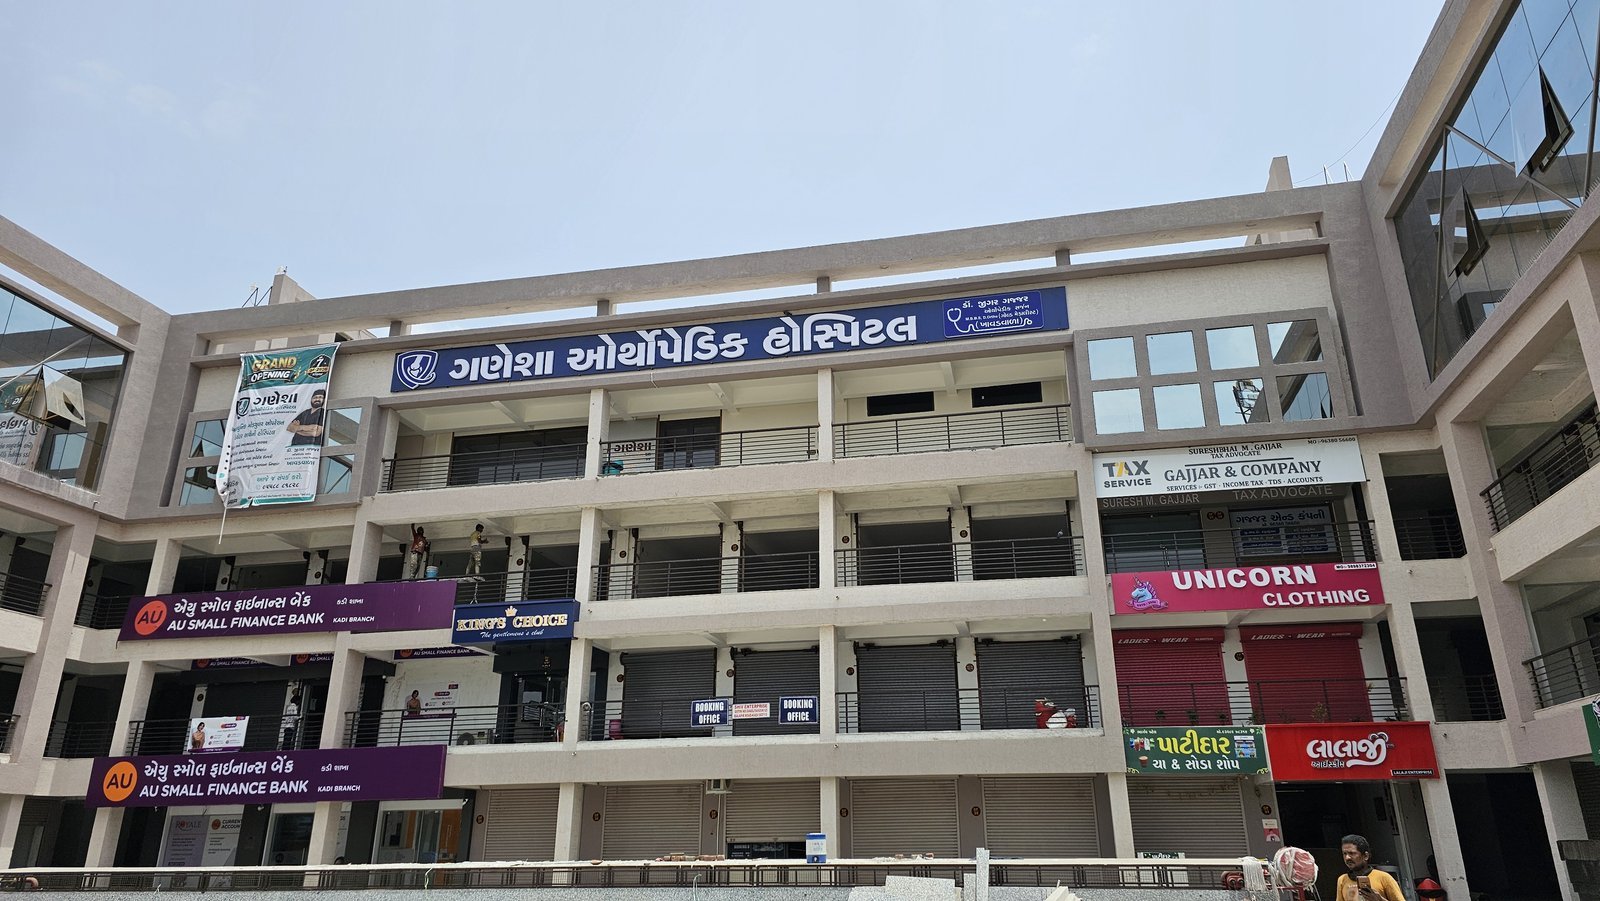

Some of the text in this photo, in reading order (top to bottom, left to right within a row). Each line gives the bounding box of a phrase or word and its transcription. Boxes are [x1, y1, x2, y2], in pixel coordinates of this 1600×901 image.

[448, 313, 917, 382] ગણેશા ઓર્થોપેડિક હોસ્પિટલ
[252, 356, 297, 371] GRAND
[250, 370, 291, 382] OPENING
[253, 391, 298, 406] ગણેશા
[1188, 445, 1238, 455] SURESHBHAI
[1254, 442, 1283, 451] GAJJAR
[1224, 450, 1261, 458] ADVOCATE
[1102, 459, 1150, 478] TAX
[1164, 460, 1321, 483] GAJJAR & COMPANY
[1103, 478, 1152, 489] SERVICE
[1166, 483, 1198, 491] SERVICES
[1287, 476, 1324, 484] ACCOUNTS
[1232, 485, 1334, 500] TAX ADVOCATE
[1103, 493, 1200, 508] SURESH M. GAJJAR
[1171, 565, 1317, 590] UNICORN
[173, 599, 197, 617] એયુ
[200, 596, 232, 613] સ્મોલ
[290, 591, 311, 608] બેંક
[1262, 588, 1370, 606] CLOTHING
[137, 610, 163, 625] AU
[167, 612, 325, 631] AU SMALL FINANCE BANK
[456, 613, 568, 632] KING'S CHOICE
[695, 702, 725, 712] BOOKING
[783, 699, 813, 709] BOOKING
[698, 714, 720, 724] OFFICE
[787, 711, 810, 721] OFFICE
[1157, 729, 1231, 755] પાટીદાર
[1306, 732, 1389, 768] લાલાજી
[144, 760, 168, 782] એયુ
[173, 759, 207, 777] સ્મોલ
[270, 755, 294, 774] બેંક
[321, 763, 333, 772] કડી
[1152, 754, 1240, 770] ચા & સોડા શોપ
[106, 773, 133, 789] AU
[139, 780, 309, 797] AU SMALL FINANCE BANK
